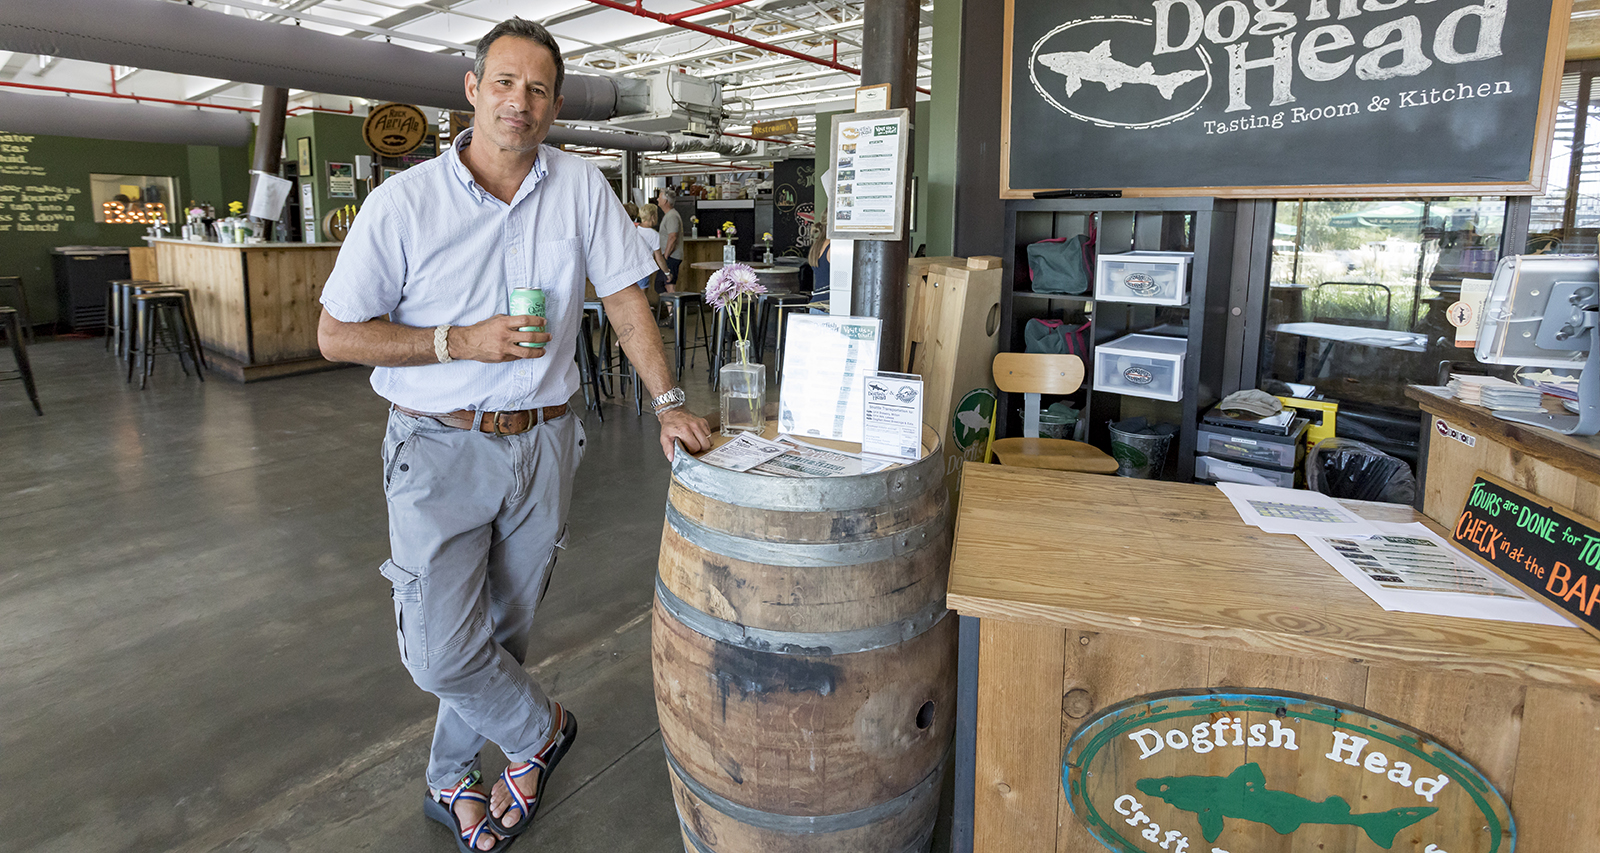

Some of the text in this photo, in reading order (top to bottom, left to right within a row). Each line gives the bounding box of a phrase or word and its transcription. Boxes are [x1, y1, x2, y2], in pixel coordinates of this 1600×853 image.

[1224, 0, 1508, 113] Head
[1203, 80, 1513, 135] Tasting Room & Kitchen
[753, 124, 787, 135] Restroom
[0, 134, 35, 143] ator
[1, 144, 29, 153] gas
[21, 191, 72, 202] journey
[25, 185, 64, 193] makes
[37, 203, 63, 212] into
[102, 201, 168, 224] BAR
[19, 212, 32, 222] &
[36, 213, 75, 222] down
[17, 223, 59, 232] hatch!
[946, 441, 984, 476] Dogfis
[1469, 482, 1600, 572] TOURS are DONE for TO
[1455, 511, 1503, 560] CHECK
[1500, 537, 1510, 554] in
[1508, 547, 1525, 563] at
[1524, 556, 1545, 579] the
[1128, 716, 1449, 803] Dogfish Head
[1113, 794, 1190, 853] Craft
